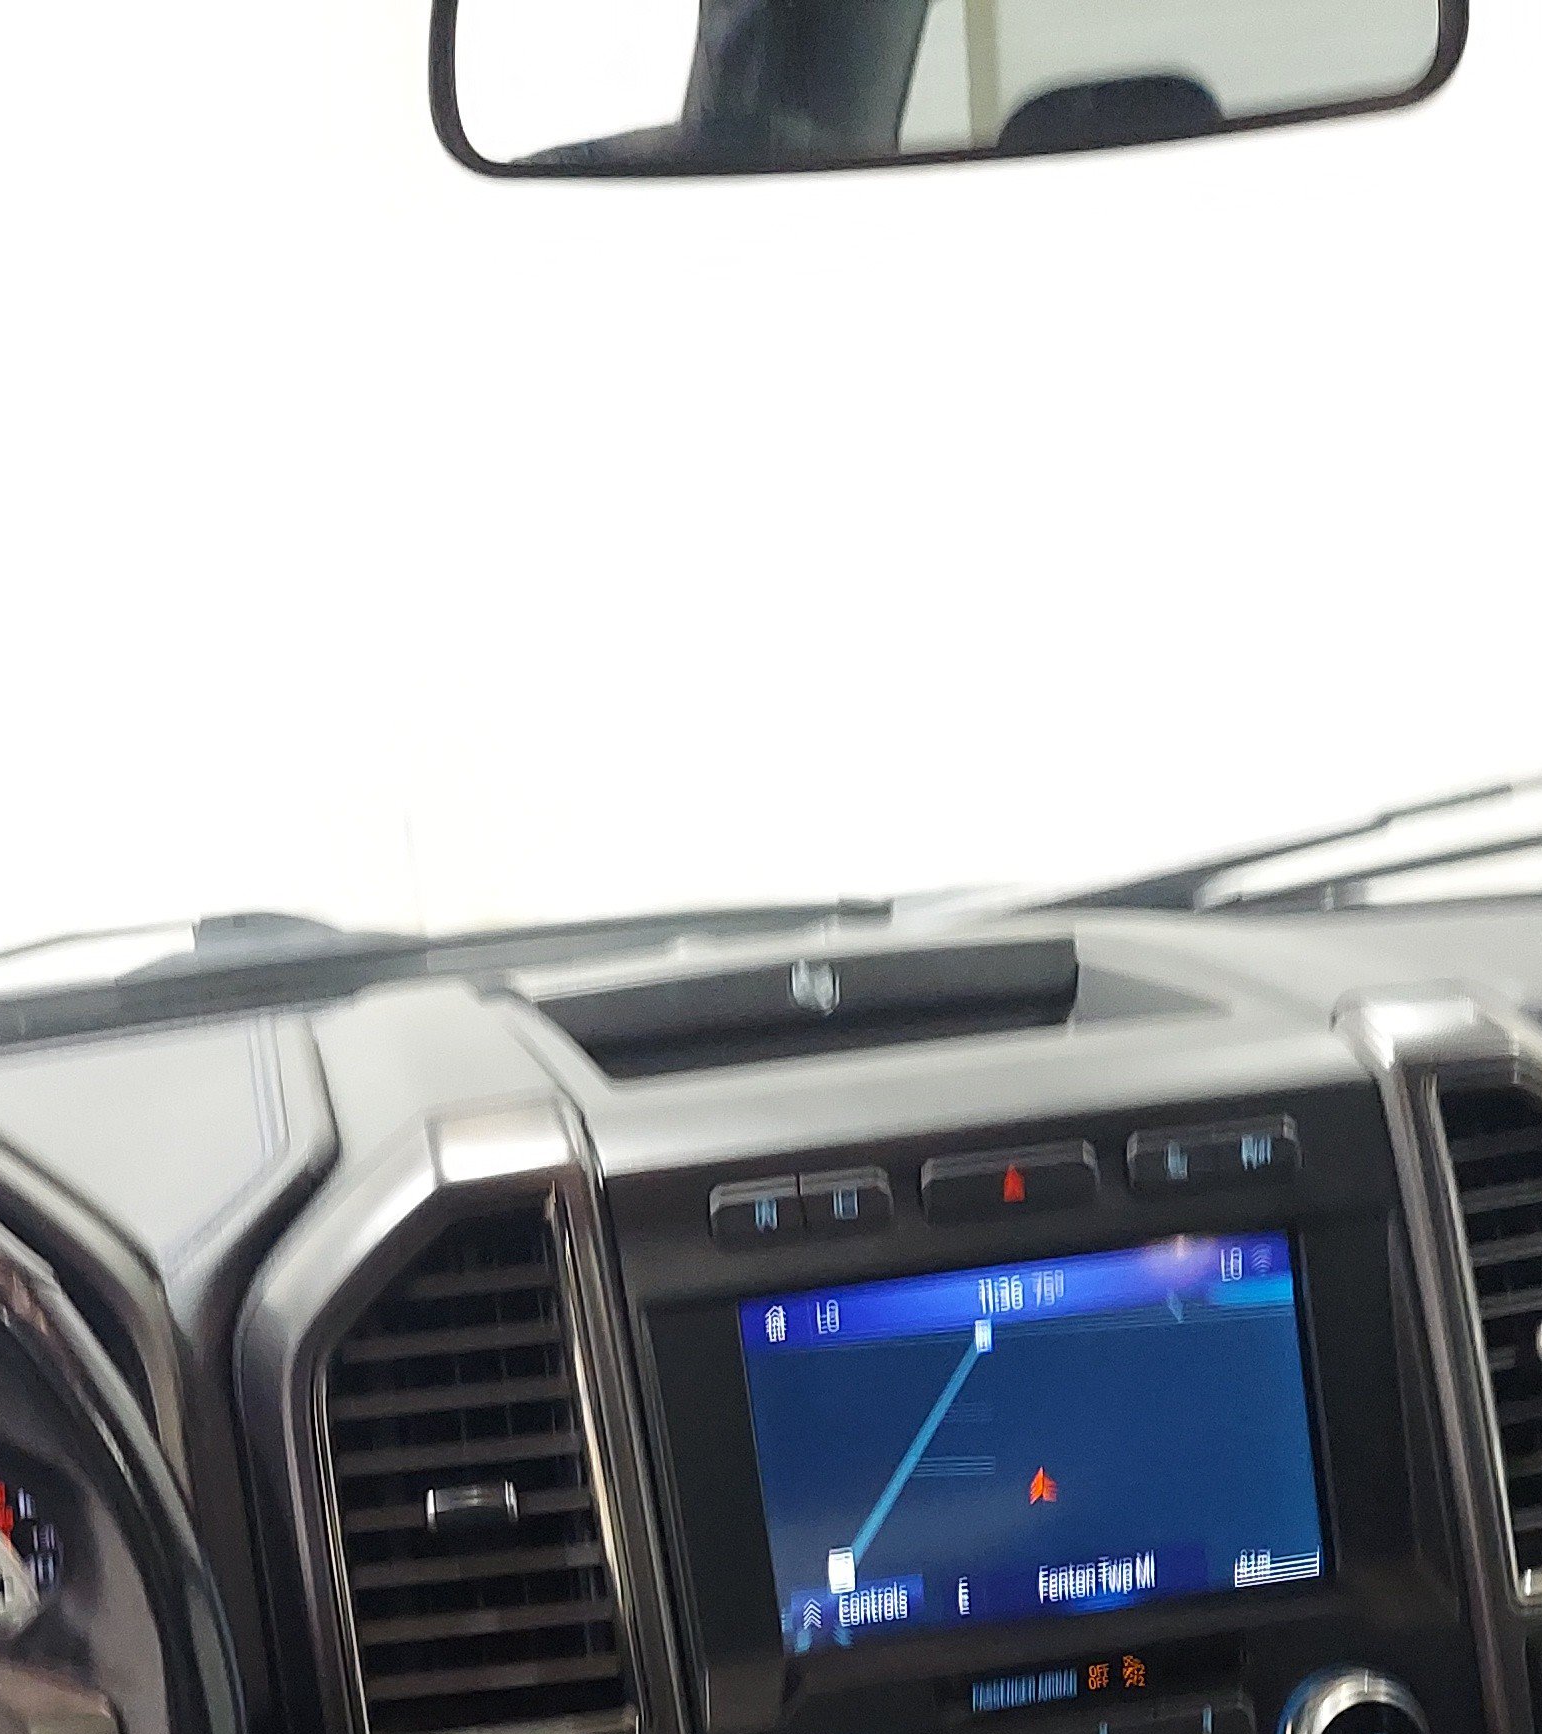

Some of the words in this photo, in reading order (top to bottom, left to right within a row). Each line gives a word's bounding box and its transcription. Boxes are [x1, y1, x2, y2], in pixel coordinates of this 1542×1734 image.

[1038, 1563, 1096, 1603] Fenton
[1098, 1556, 1132, 1595] Twp
[1135, 1549, 1156, 1589] MI
[838, 1581, 908, 1627] Controls
